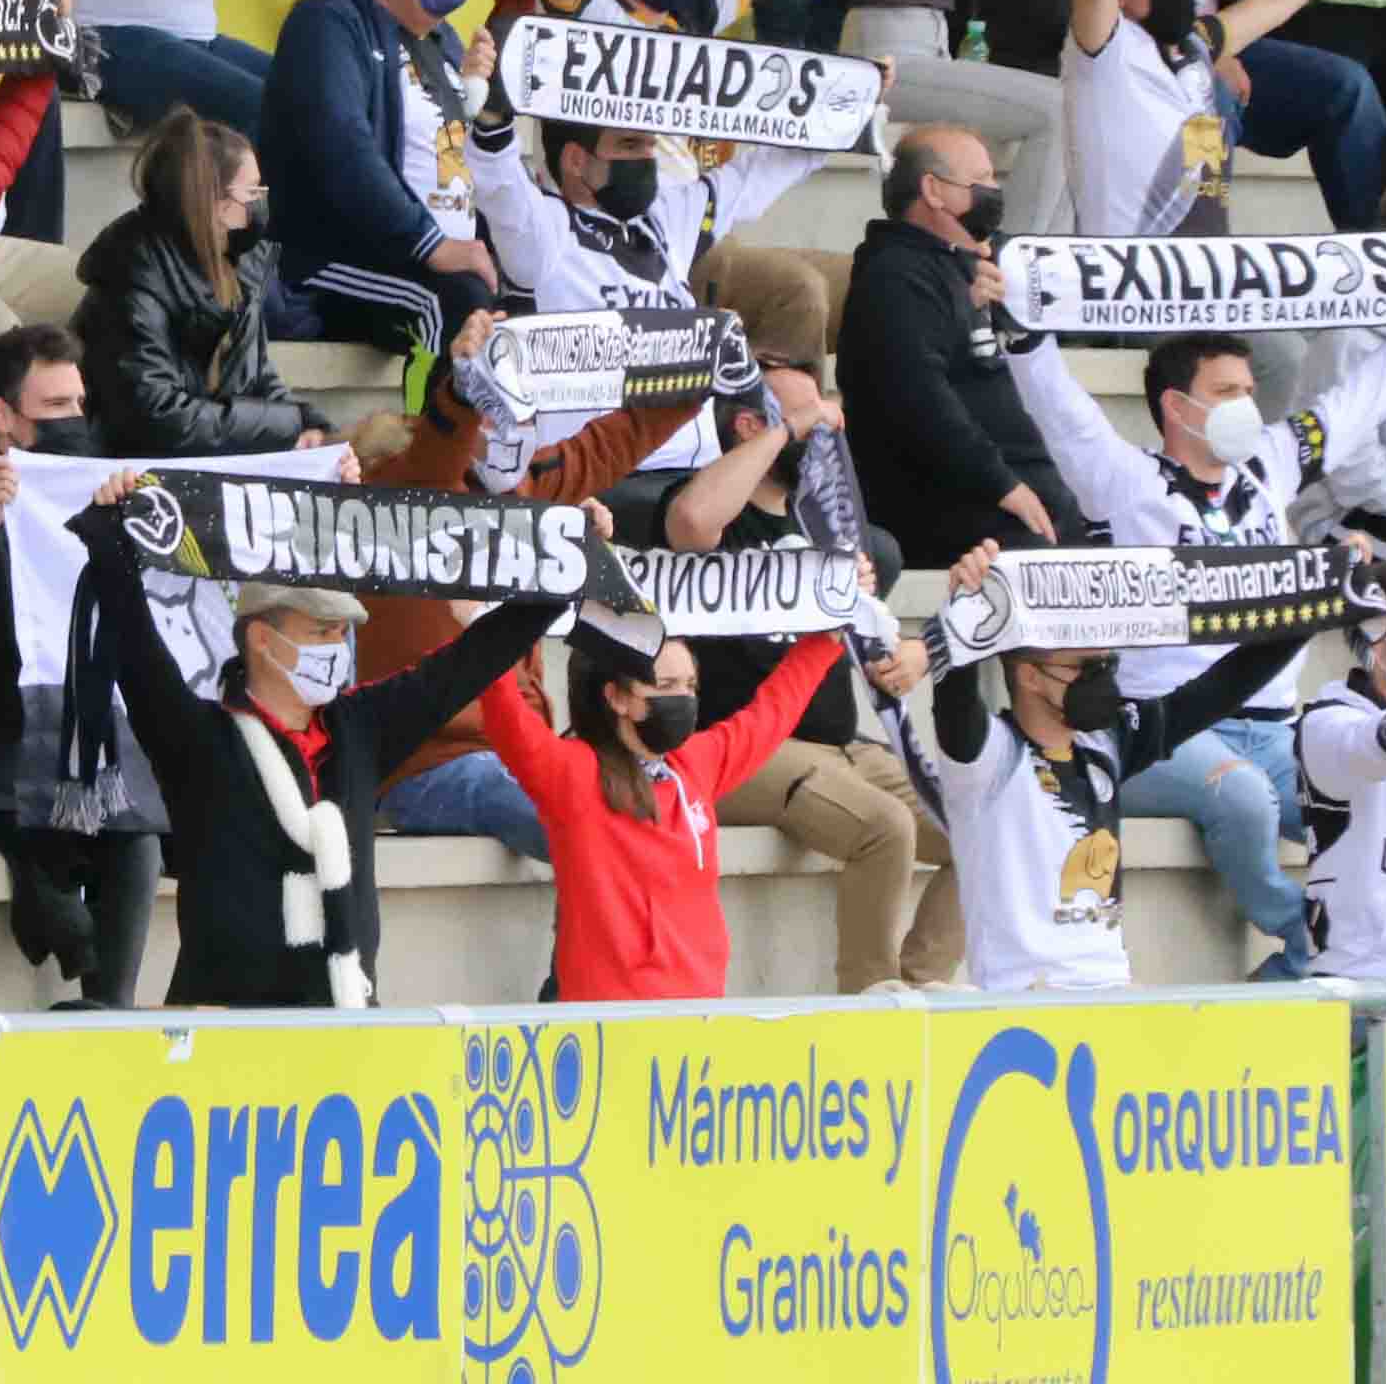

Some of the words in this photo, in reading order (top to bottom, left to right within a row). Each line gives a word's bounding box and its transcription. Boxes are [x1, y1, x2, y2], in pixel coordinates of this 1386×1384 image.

[560, 94, 665, 127] UNIONISTAS
[671, 106, 694, 130] DE
[698, 108, 811, 143] SALAMANCA
[1082, 302, 1216, 325] UNIONISTAS
[1225, 302, 1253, 324] DE
[221, 482, 587, 595] UNIONISTAS
[1019, 560, 1142, 609] UNIONISTAS
[1173, 556, 1297, 605] Salamanca
[647, 1043, 871, 1168] Mármoles
[884, 1079, 913, 1186] y
[1113, 1067, 1344, 1175] ORQUÍDEA
[719, 1223, 910, 1337] Granitos
[1135, 1261, 1324, 1331] restaurante
